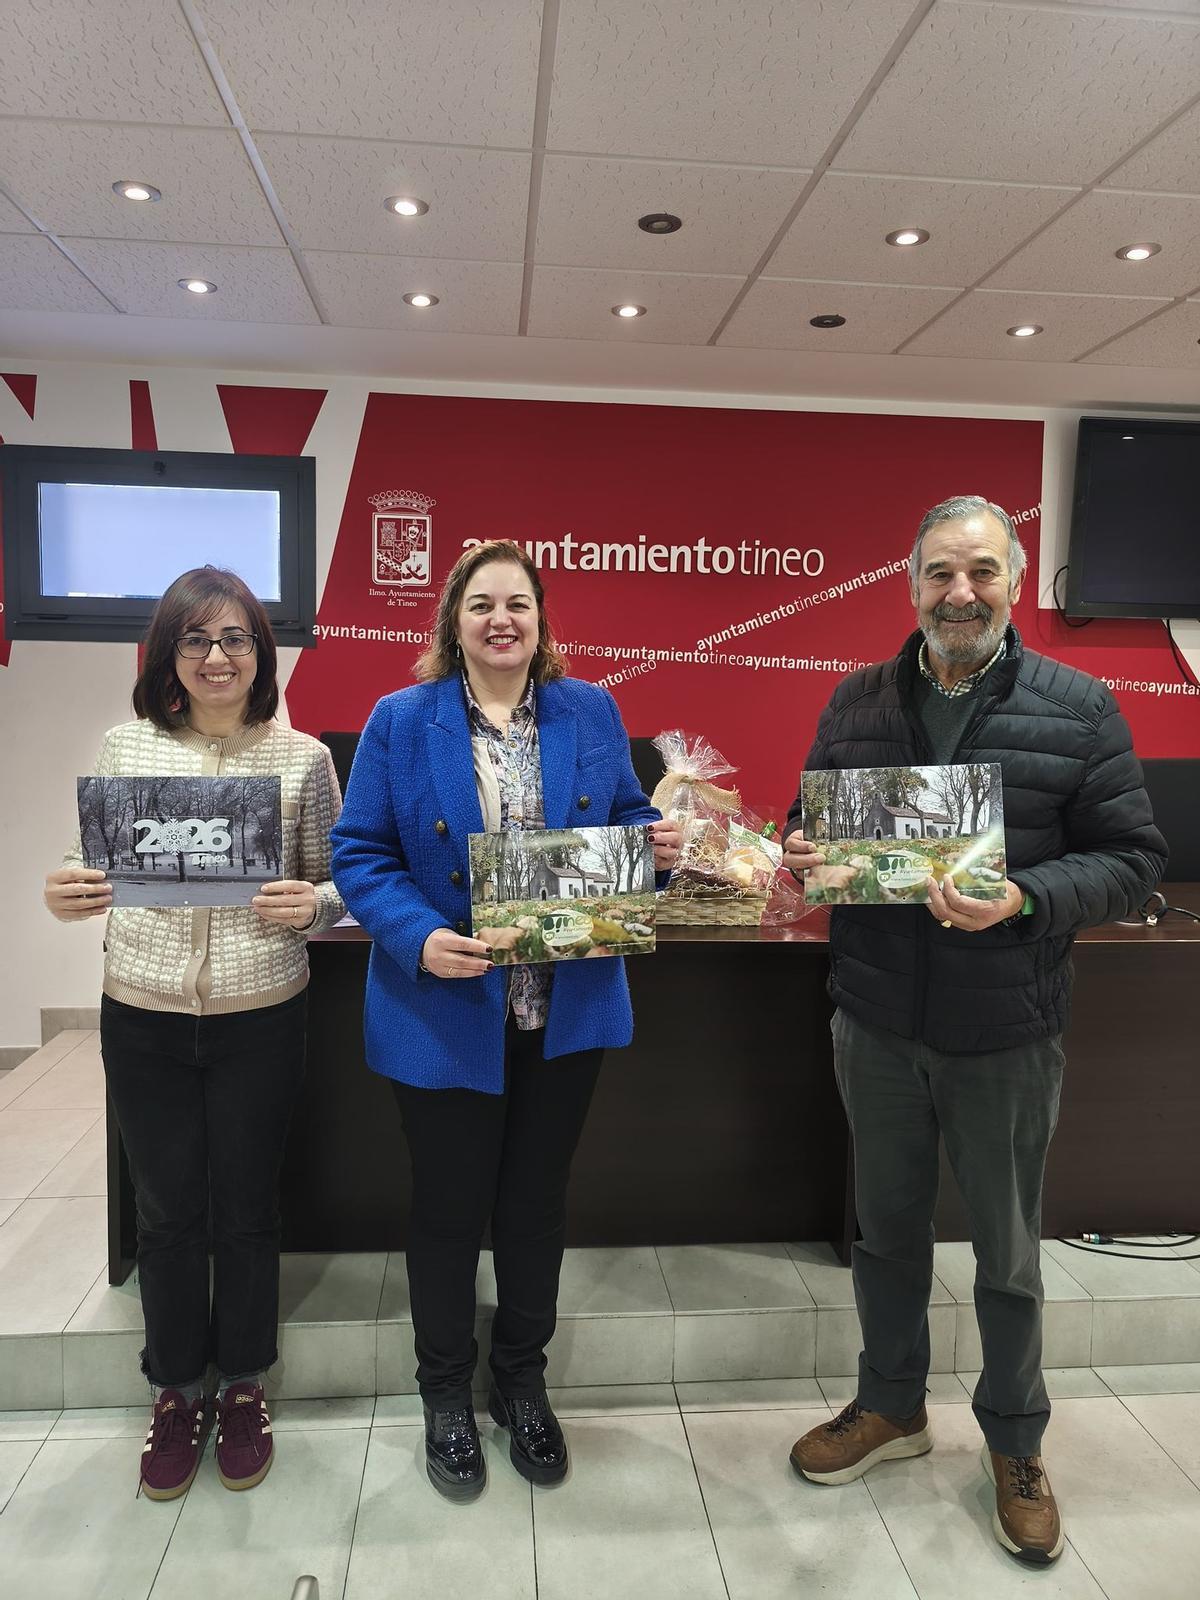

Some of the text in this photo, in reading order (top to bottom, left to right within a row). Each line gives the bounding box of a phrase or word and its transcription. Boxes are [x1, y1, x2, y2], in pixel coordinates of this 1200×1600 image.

[388, 589, 436, 599] Ayuntamiento
[386, 598, 418, 608] de Tineo
